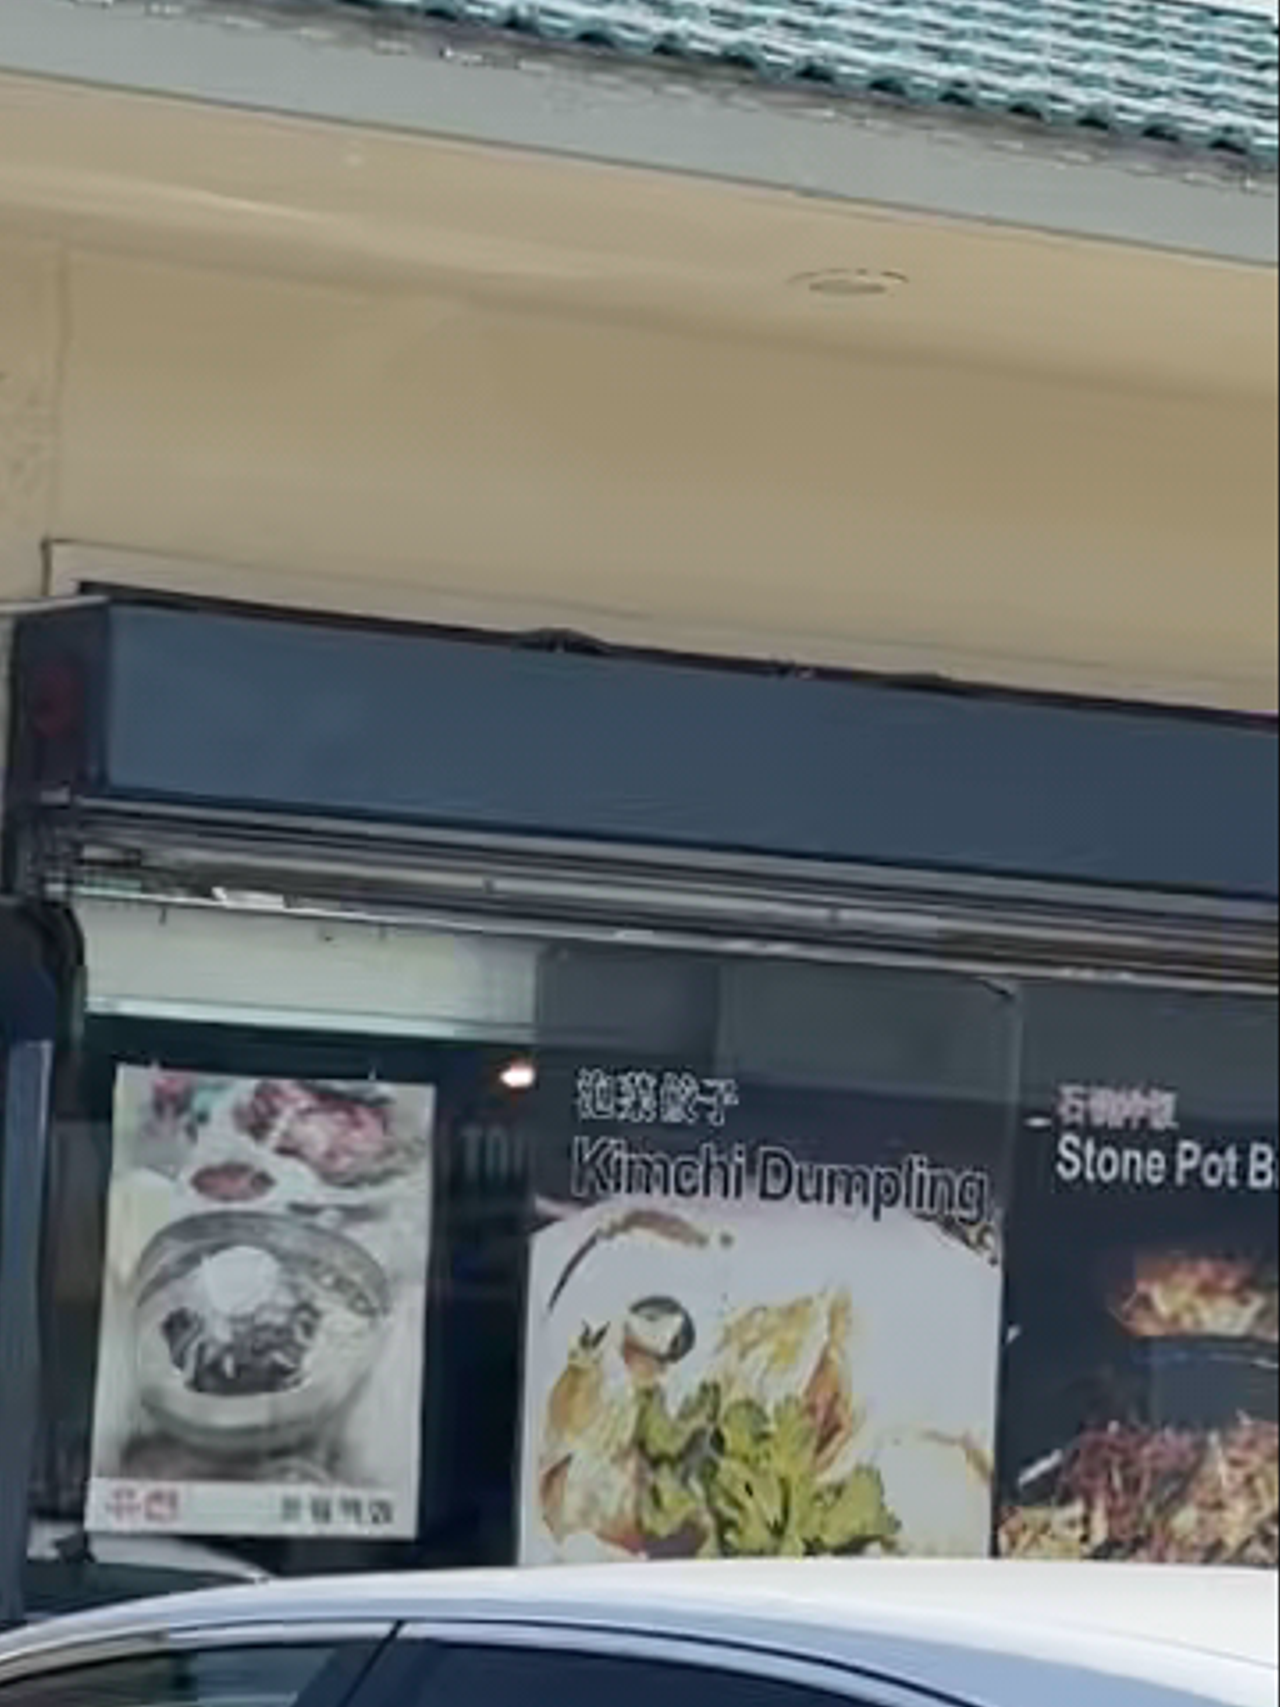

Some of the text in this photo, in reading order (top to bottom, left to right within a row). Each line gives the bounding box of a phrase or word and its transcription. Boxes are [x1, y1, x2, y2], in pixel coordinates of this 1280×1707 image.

[571, 1135, 746, 1199] Kimchi
[756, 1145, 989, 1223] Dumpling
[1056, 1133, 1166, 1184] Stone
[1176, 1139, 1239, 1187] Pot
